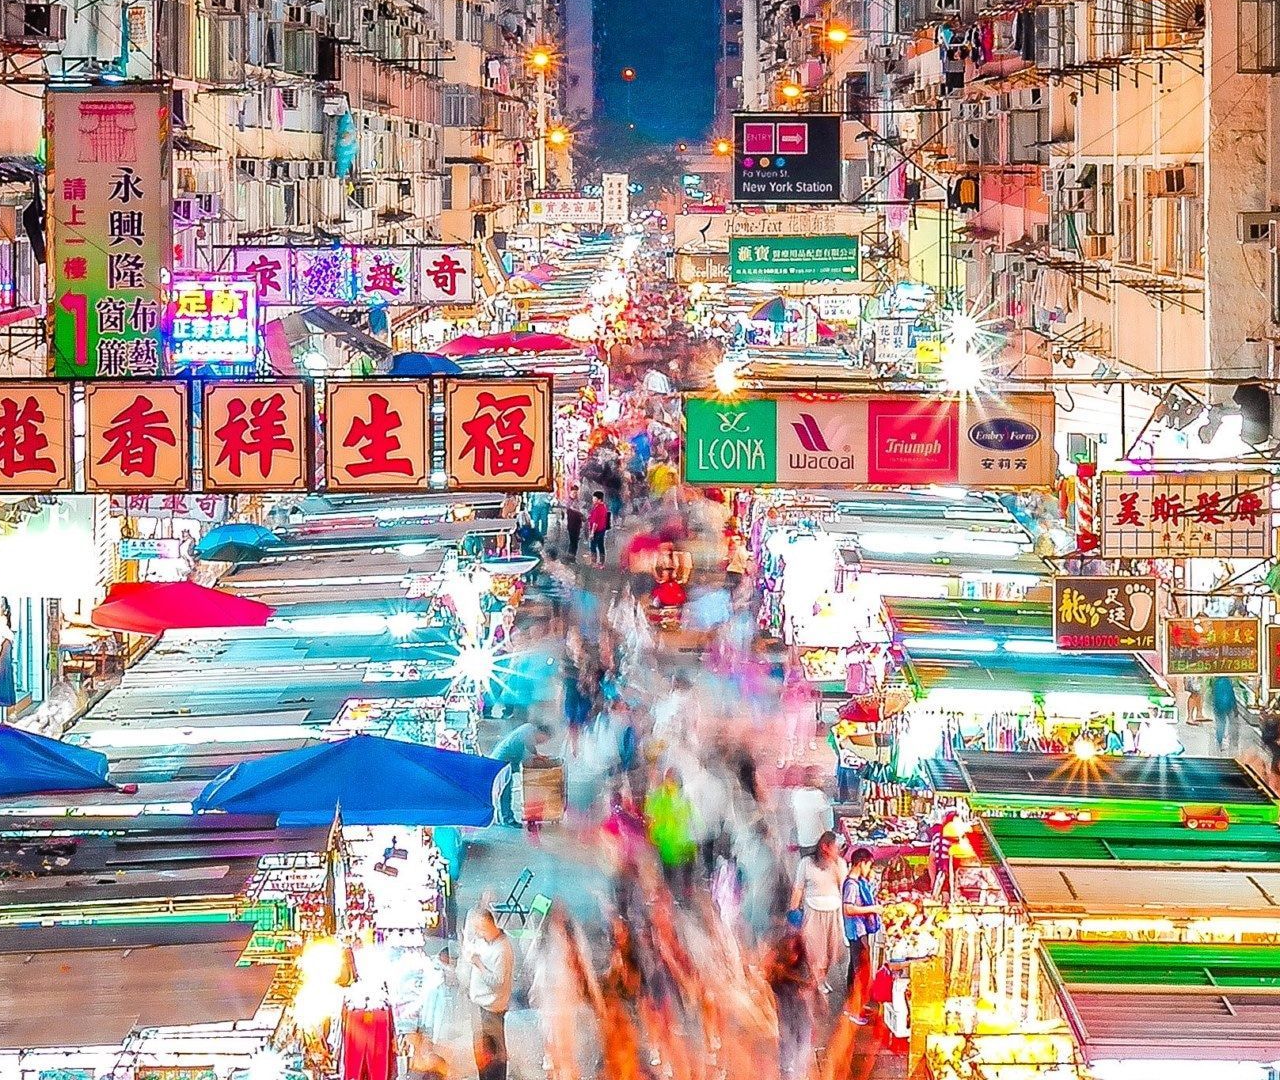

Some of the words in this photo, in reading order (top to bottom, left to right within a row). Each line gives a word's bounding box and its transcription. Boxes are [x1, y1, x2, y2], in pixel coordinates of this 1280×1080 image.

[756, 170, 778, 178] Yuen
[742, 182, 766, 192] New
[768, 182, 793, 192] York
[796, 181, 833, 192] Station
[63, 177, 88, 280] 請上一樓
[107, 166, 146, 290] 永興隆
[975, 429, 1006, 444] Embry
[1009, 430, 1037, 442] Form
[698, 438, 766, 471] LEONA
[885, 437, 942, 457] Triumph
[789, 453, 855, 470] Wacoal
[980, 457, 1028, 470] 安莉芳
[1112, 491, 1263, 527] 美斯髮廊
[1135, 635, 1154, 647] 1/F
